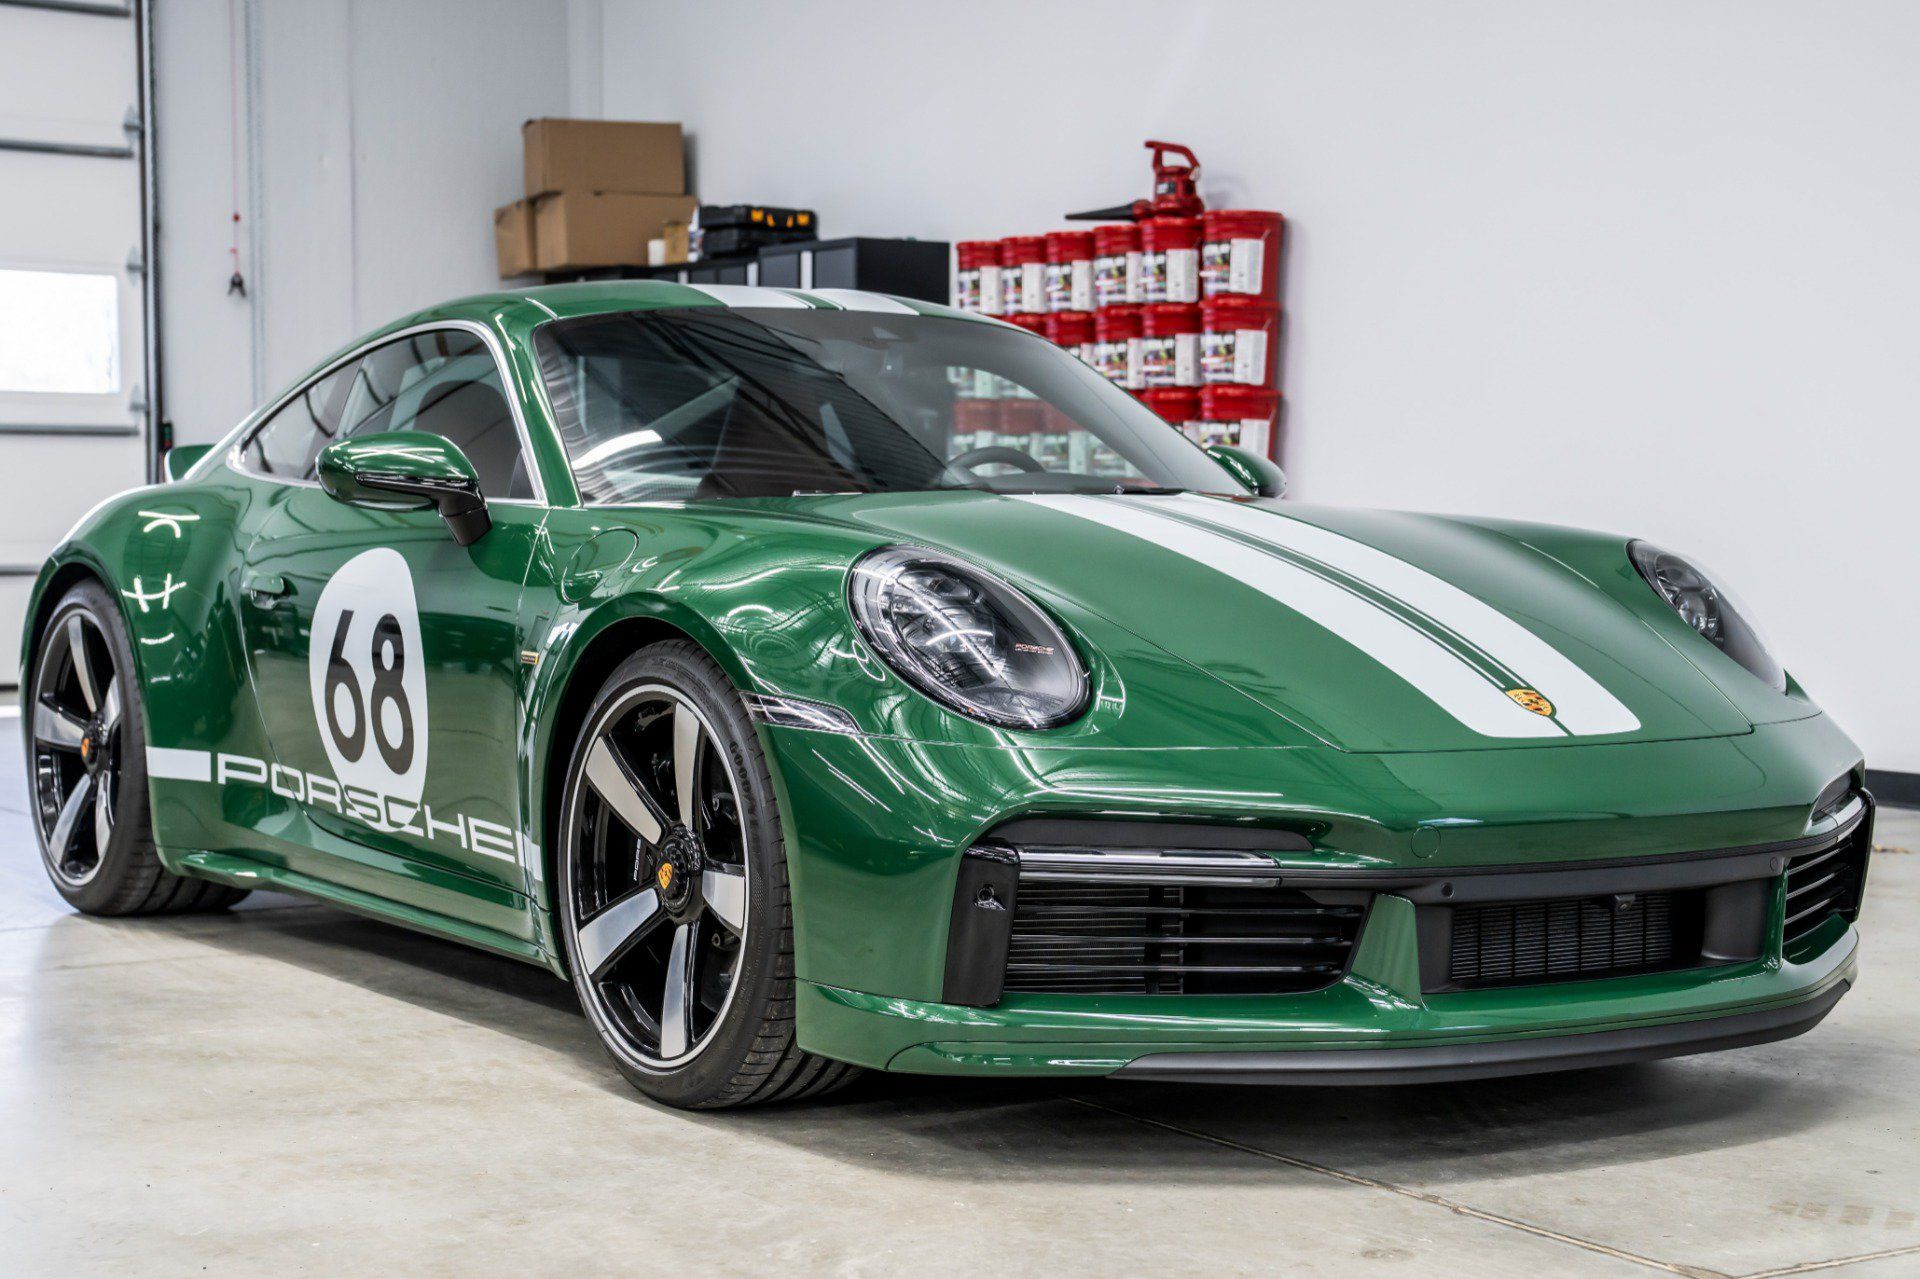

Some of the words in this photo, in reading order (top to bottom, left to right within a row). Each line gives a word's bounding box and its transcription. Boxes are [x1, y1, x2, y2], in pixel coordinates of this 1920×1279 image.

[325, 609, 414, 775] 68
[217, 752, 516, 864] PORSCHE
[633, 838, 641, 881] PORS
